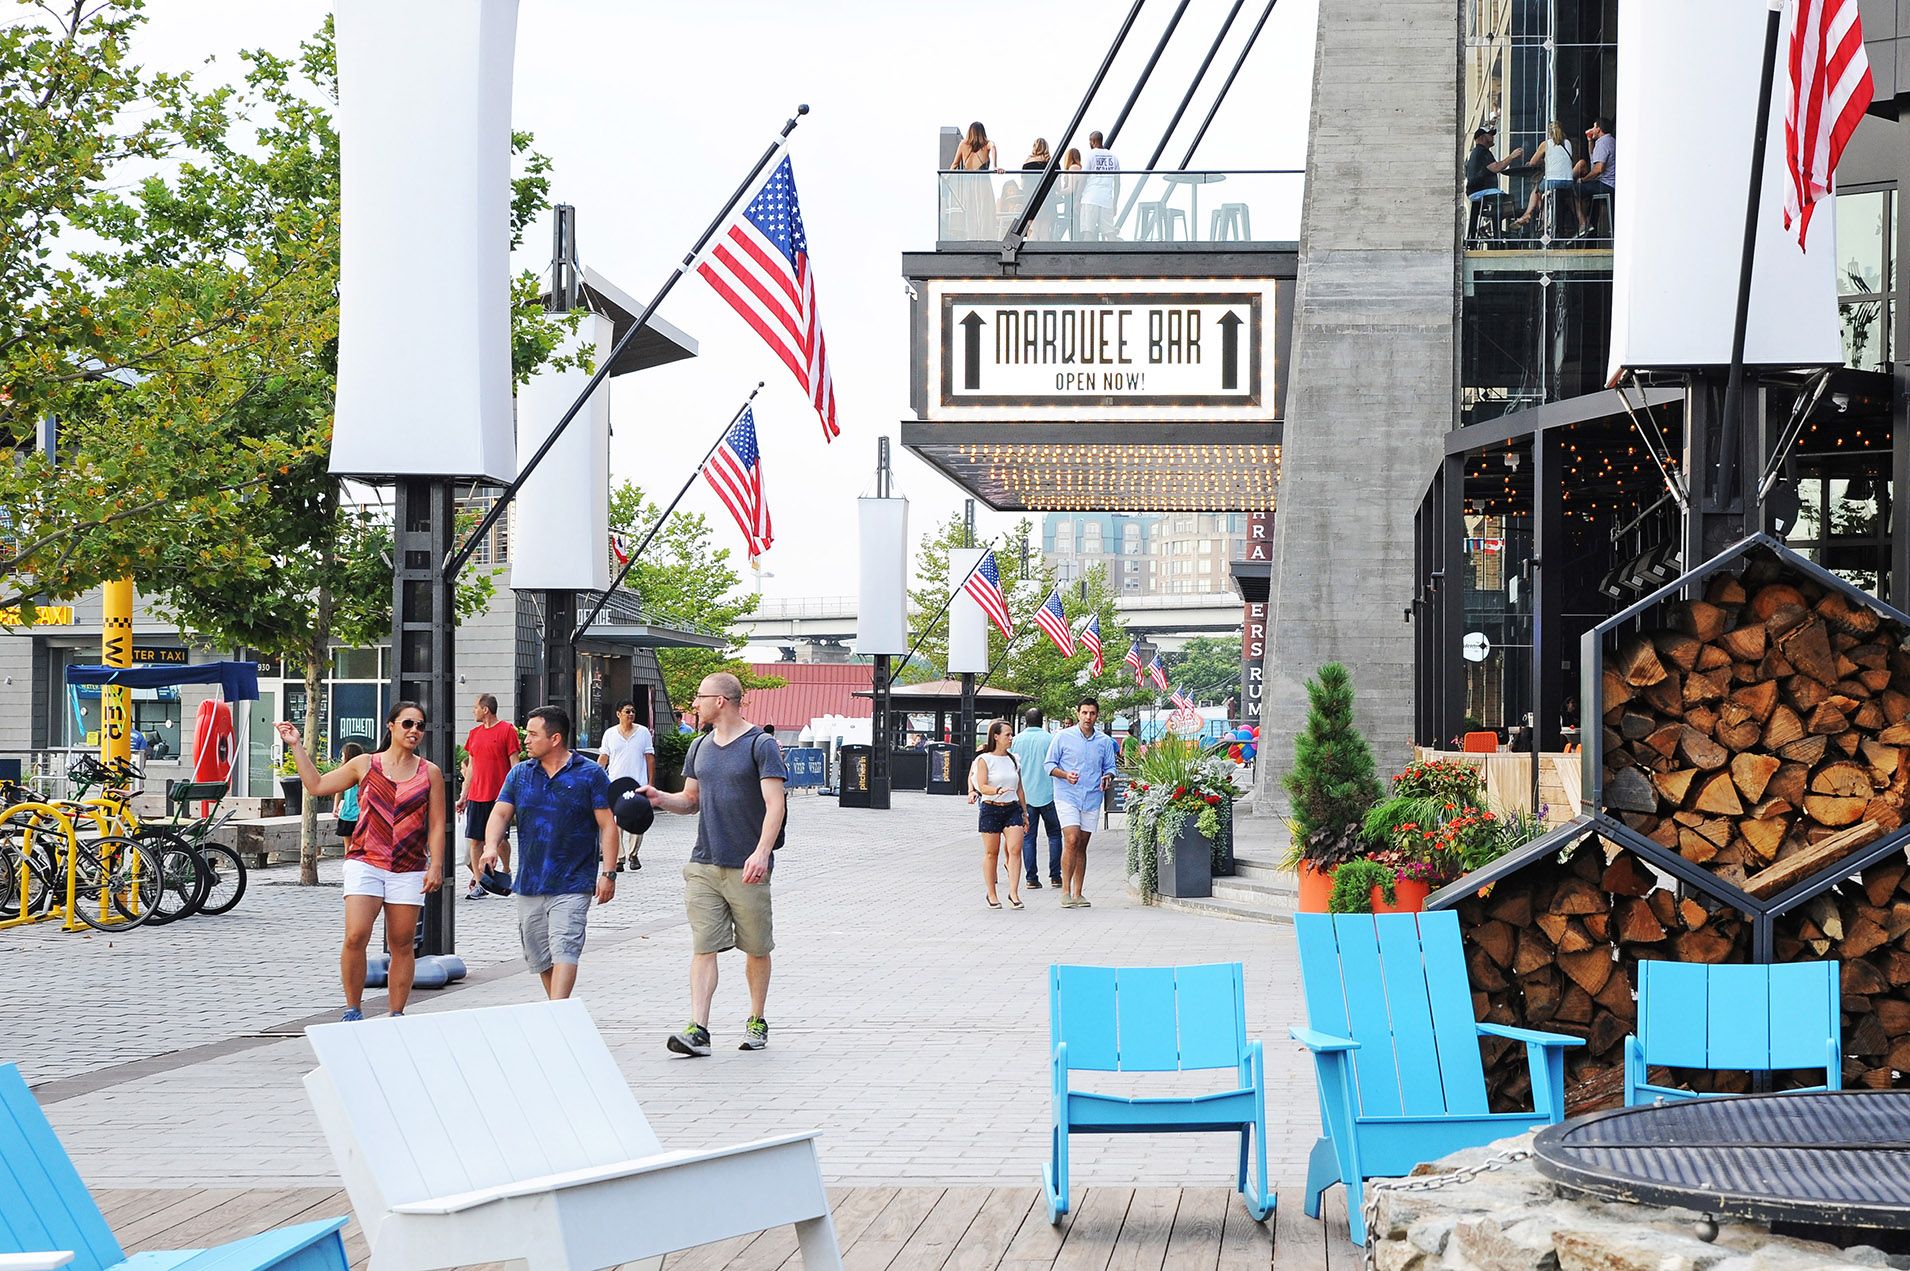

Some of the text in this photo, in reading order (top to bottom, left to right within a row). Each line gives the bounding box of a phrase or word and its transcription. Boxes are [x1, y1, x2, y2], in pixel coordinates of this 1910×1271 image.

[995, 309, 1201, 365] MARQUEE BAR
[1055, 372, 1146, 391] OPEN NOW!
[35, 606, 68, 625] AXI
[160, 651, 186, 661] TAXI
[1248, 667, 1263, 716] RUM
[339, 717, 375, 740] ANTHEM
